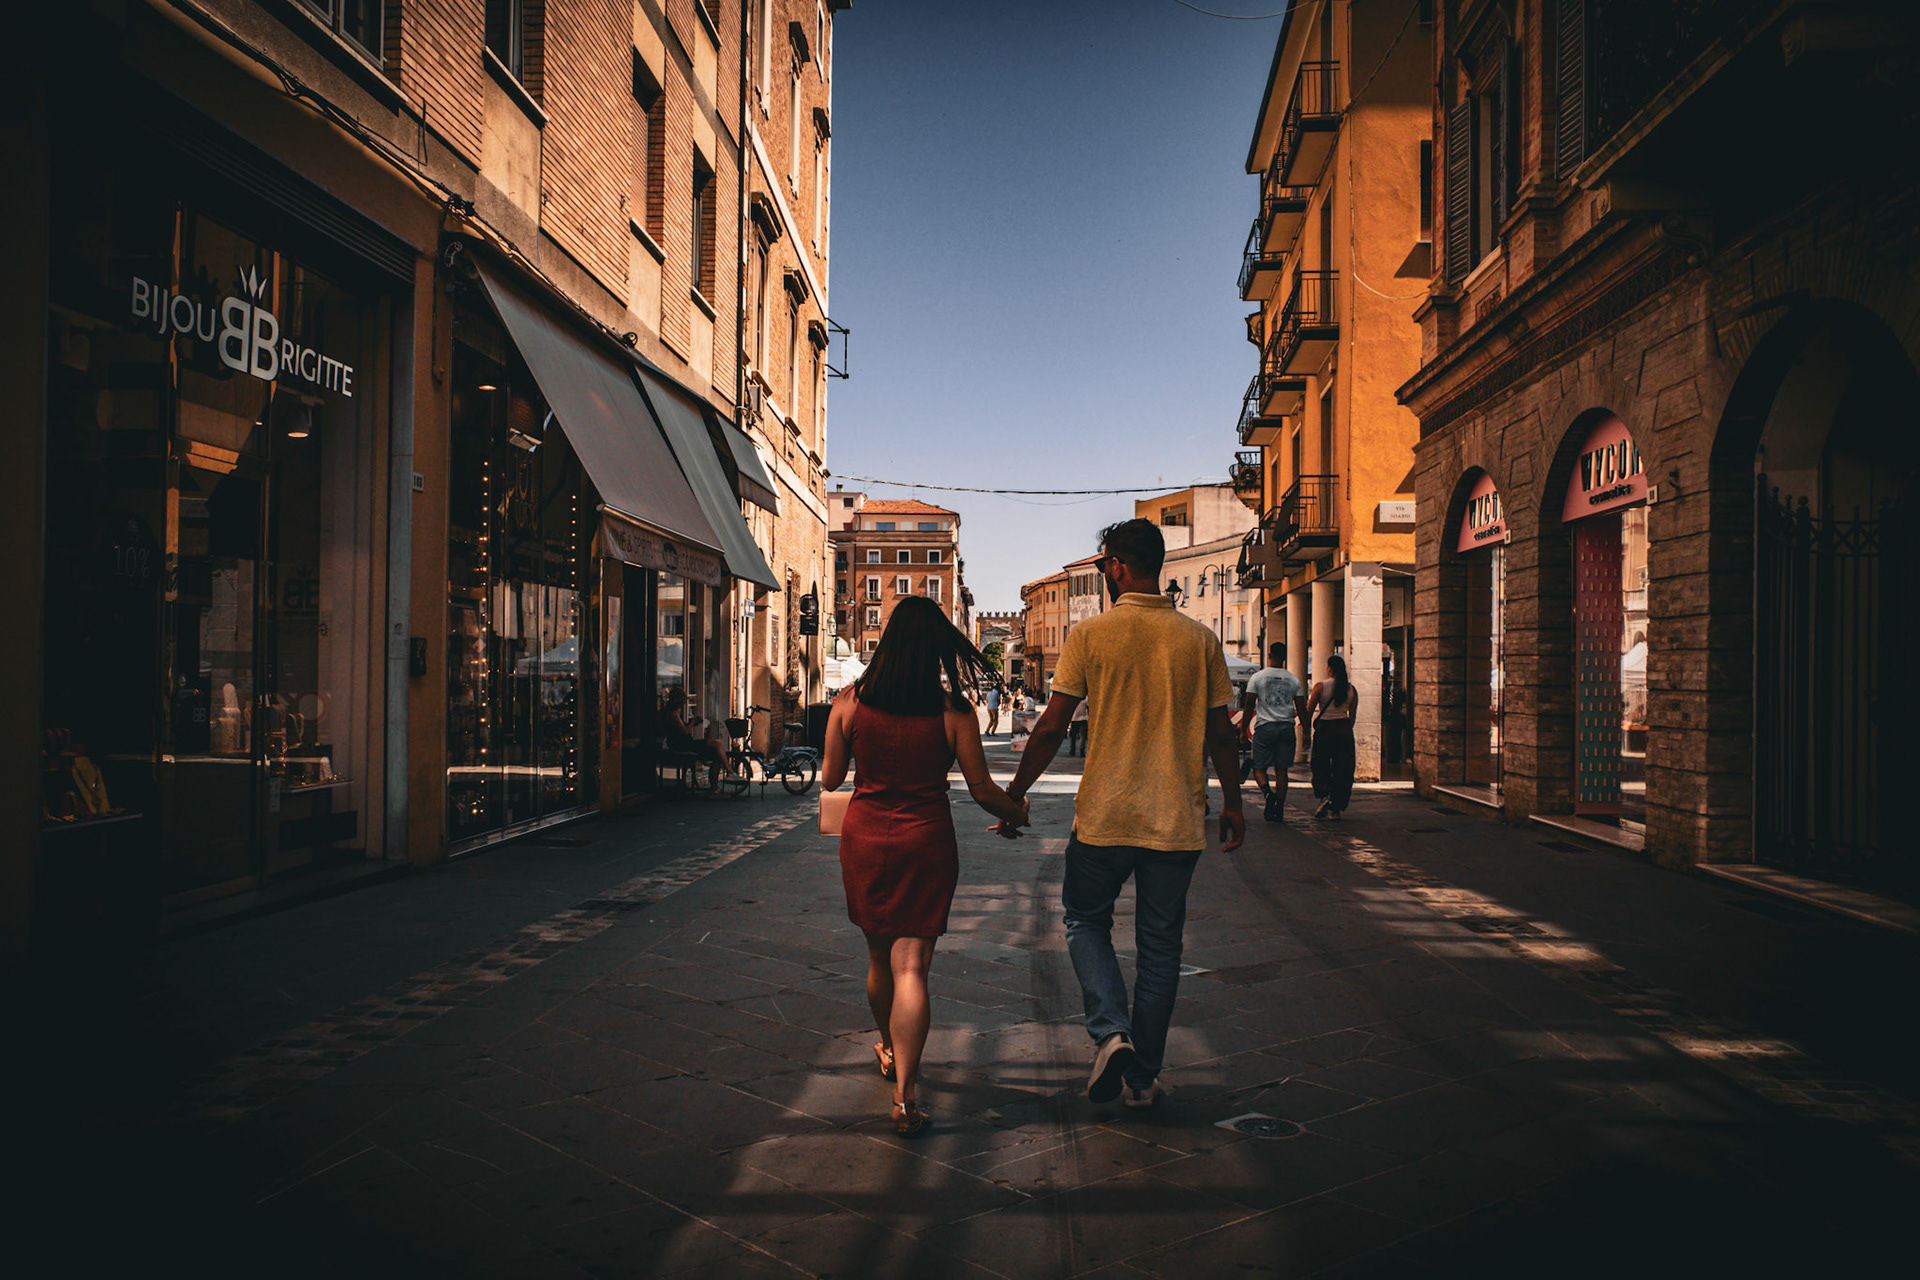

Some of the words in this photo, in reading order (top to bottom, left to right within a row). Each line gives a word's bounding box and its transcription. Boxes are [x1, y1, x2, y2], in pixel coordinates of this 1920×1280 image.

[131, 275, 216, 342] BIJOU
[1468, 491, 1505, 530] WYCO
[1589, 484, 1632, 505] cosmetics
